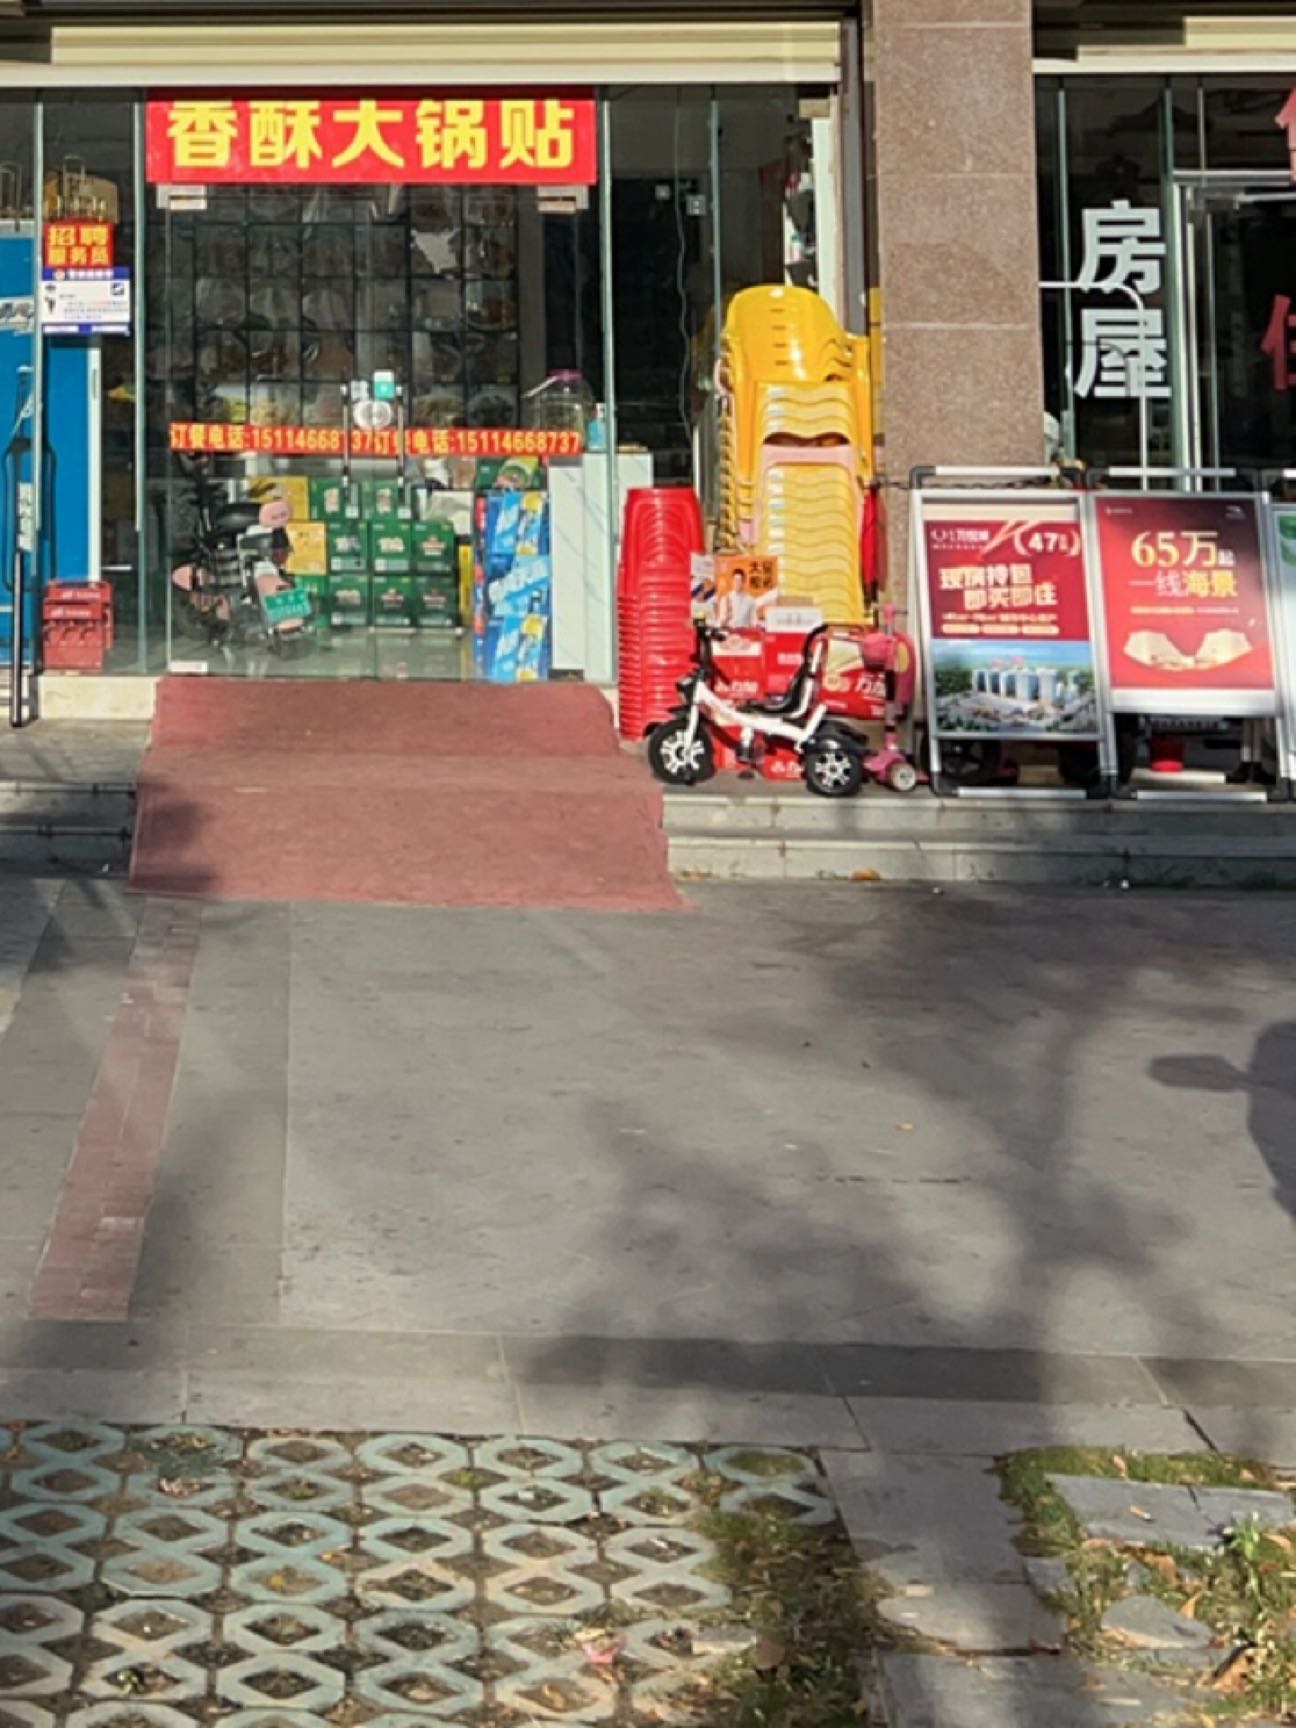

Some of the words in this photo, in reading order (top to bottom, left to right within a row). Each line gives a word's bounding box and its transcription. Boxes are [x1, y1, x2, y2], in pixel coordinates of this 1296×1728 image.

[166, 97, 575, 170] 香酥大锅贴
[49, 224, 109, 246] 招聘
[1073, 199, 1173, 399] 房屋
